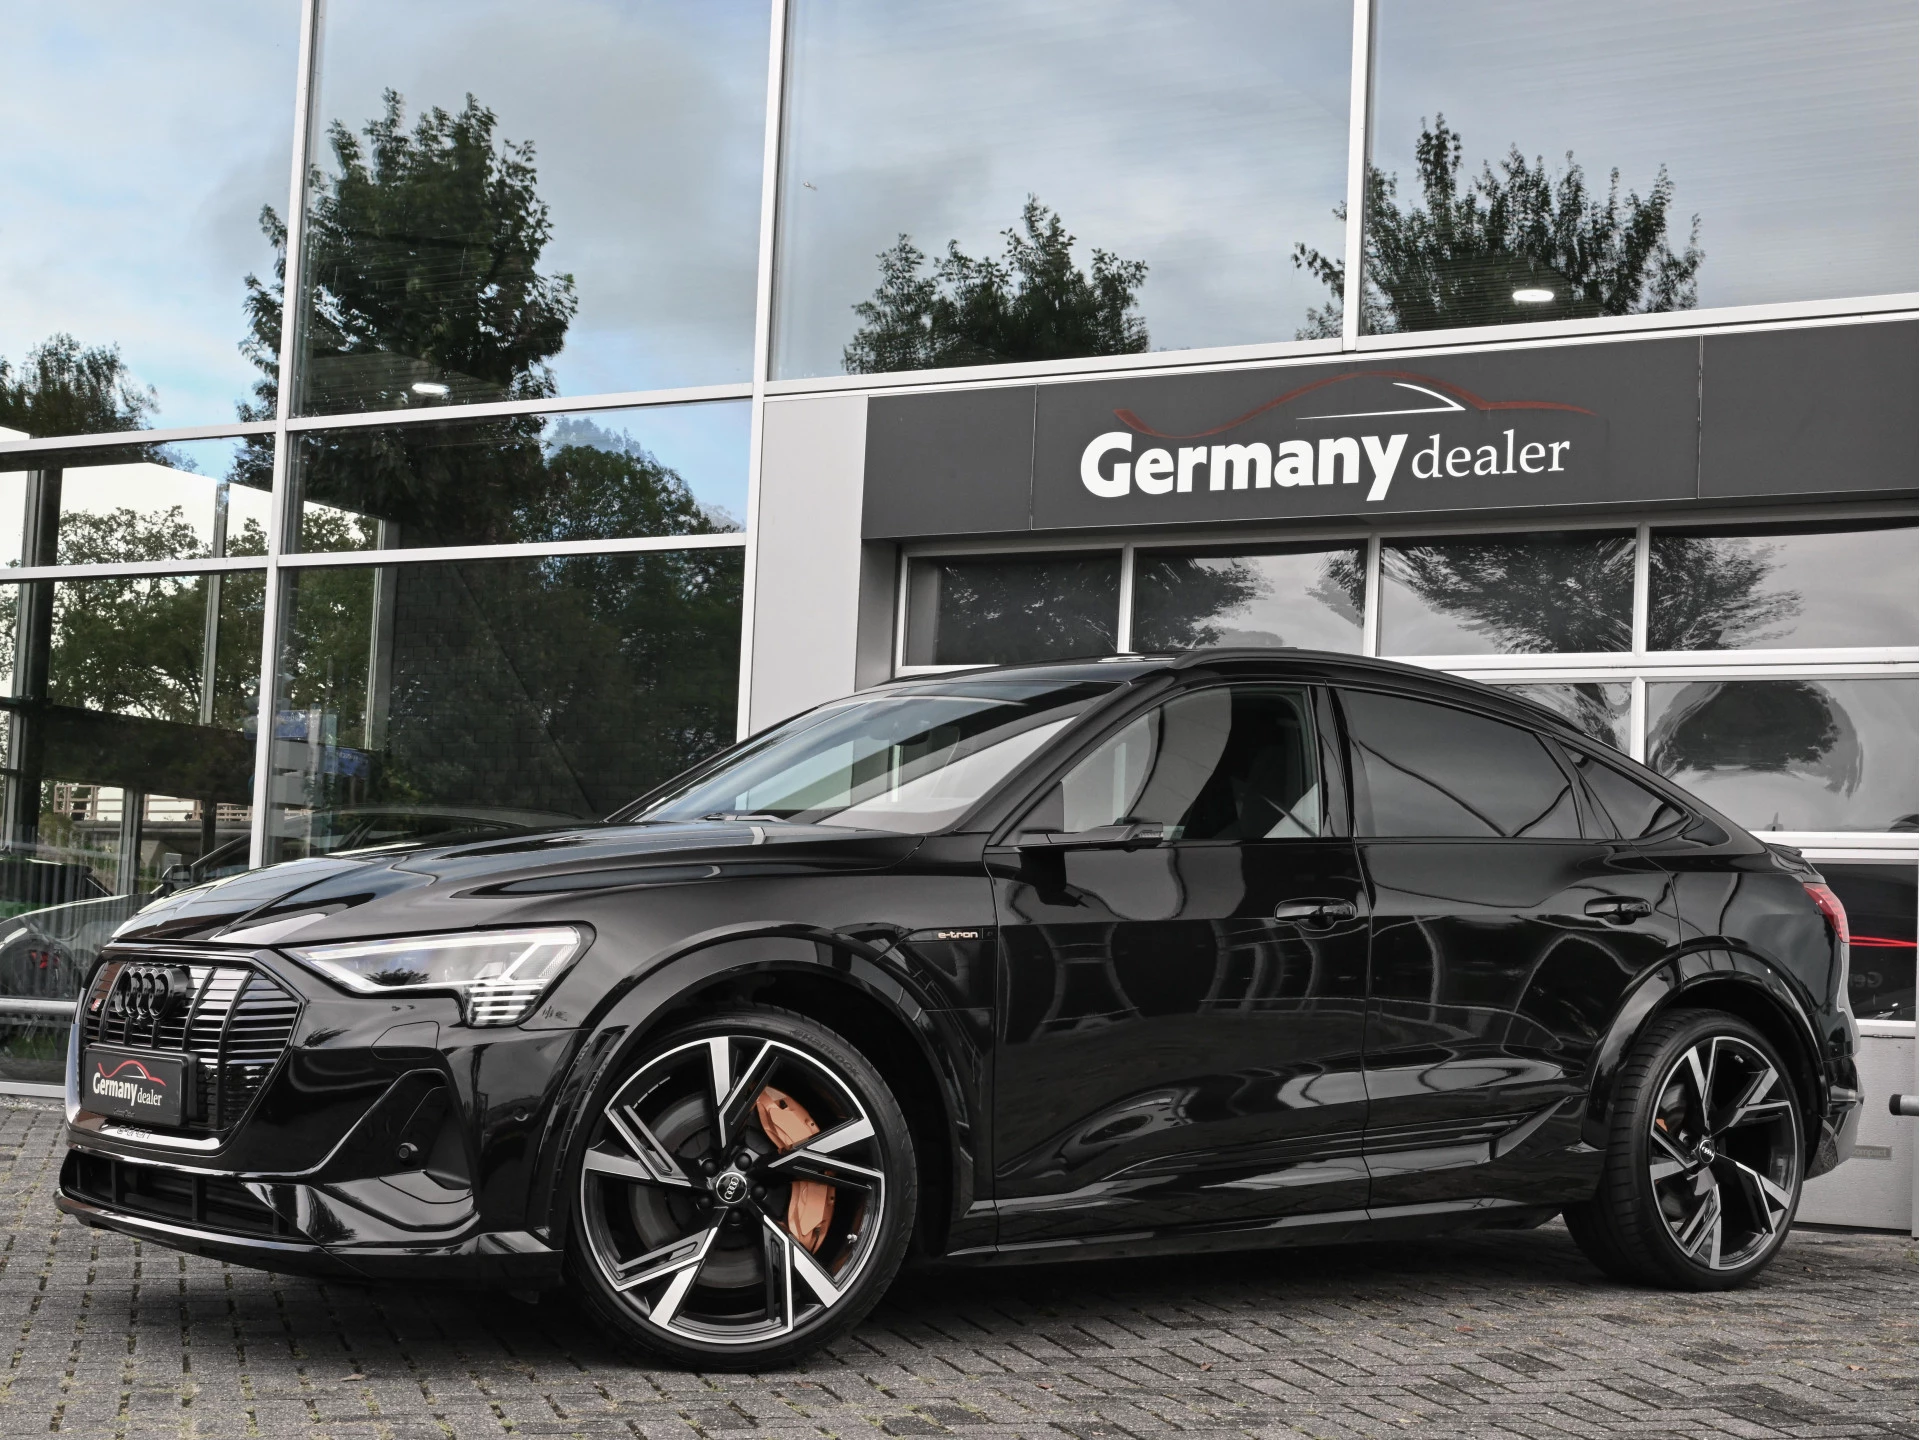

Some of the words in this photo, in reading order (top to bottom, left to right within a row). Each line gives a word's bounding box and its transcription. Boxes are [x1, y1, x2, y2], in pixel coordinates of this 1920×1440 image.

[1080, 431, 1408, 502] Germany
[1411, 429, 1570, 480] dealer
[938, 930, 979, 939] e-tron
[92, 1072, 138, 1107] Germany
[137, 1087, 163, 1106] dealer
[116, 1124, 153, 1140] e-tron
